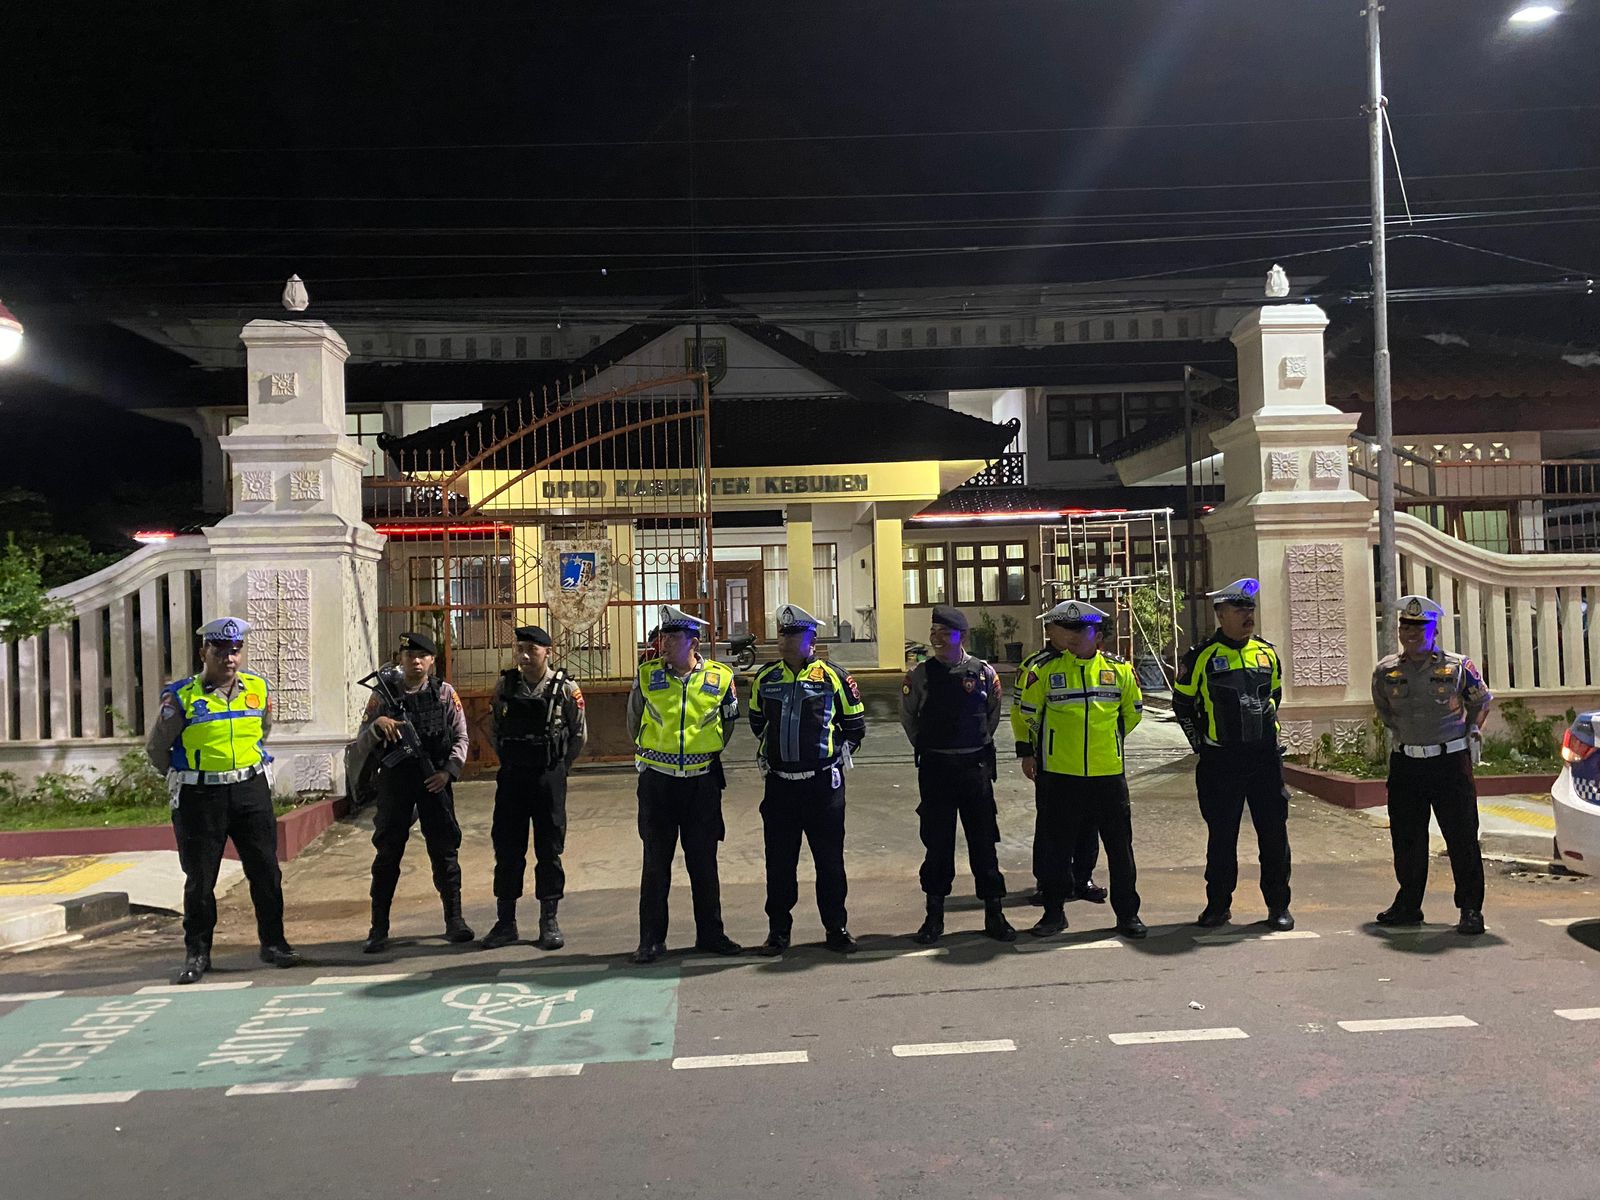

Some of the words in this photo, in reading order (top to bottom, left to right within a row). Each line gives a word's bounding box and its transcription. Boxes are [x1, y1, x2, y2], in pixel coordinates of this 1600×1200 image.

[616, 477, 750, 497] KABUPTEN
[764, 474, 868, 494] KEBUMEN
[198, 992, 343, 1067] LAJUR
